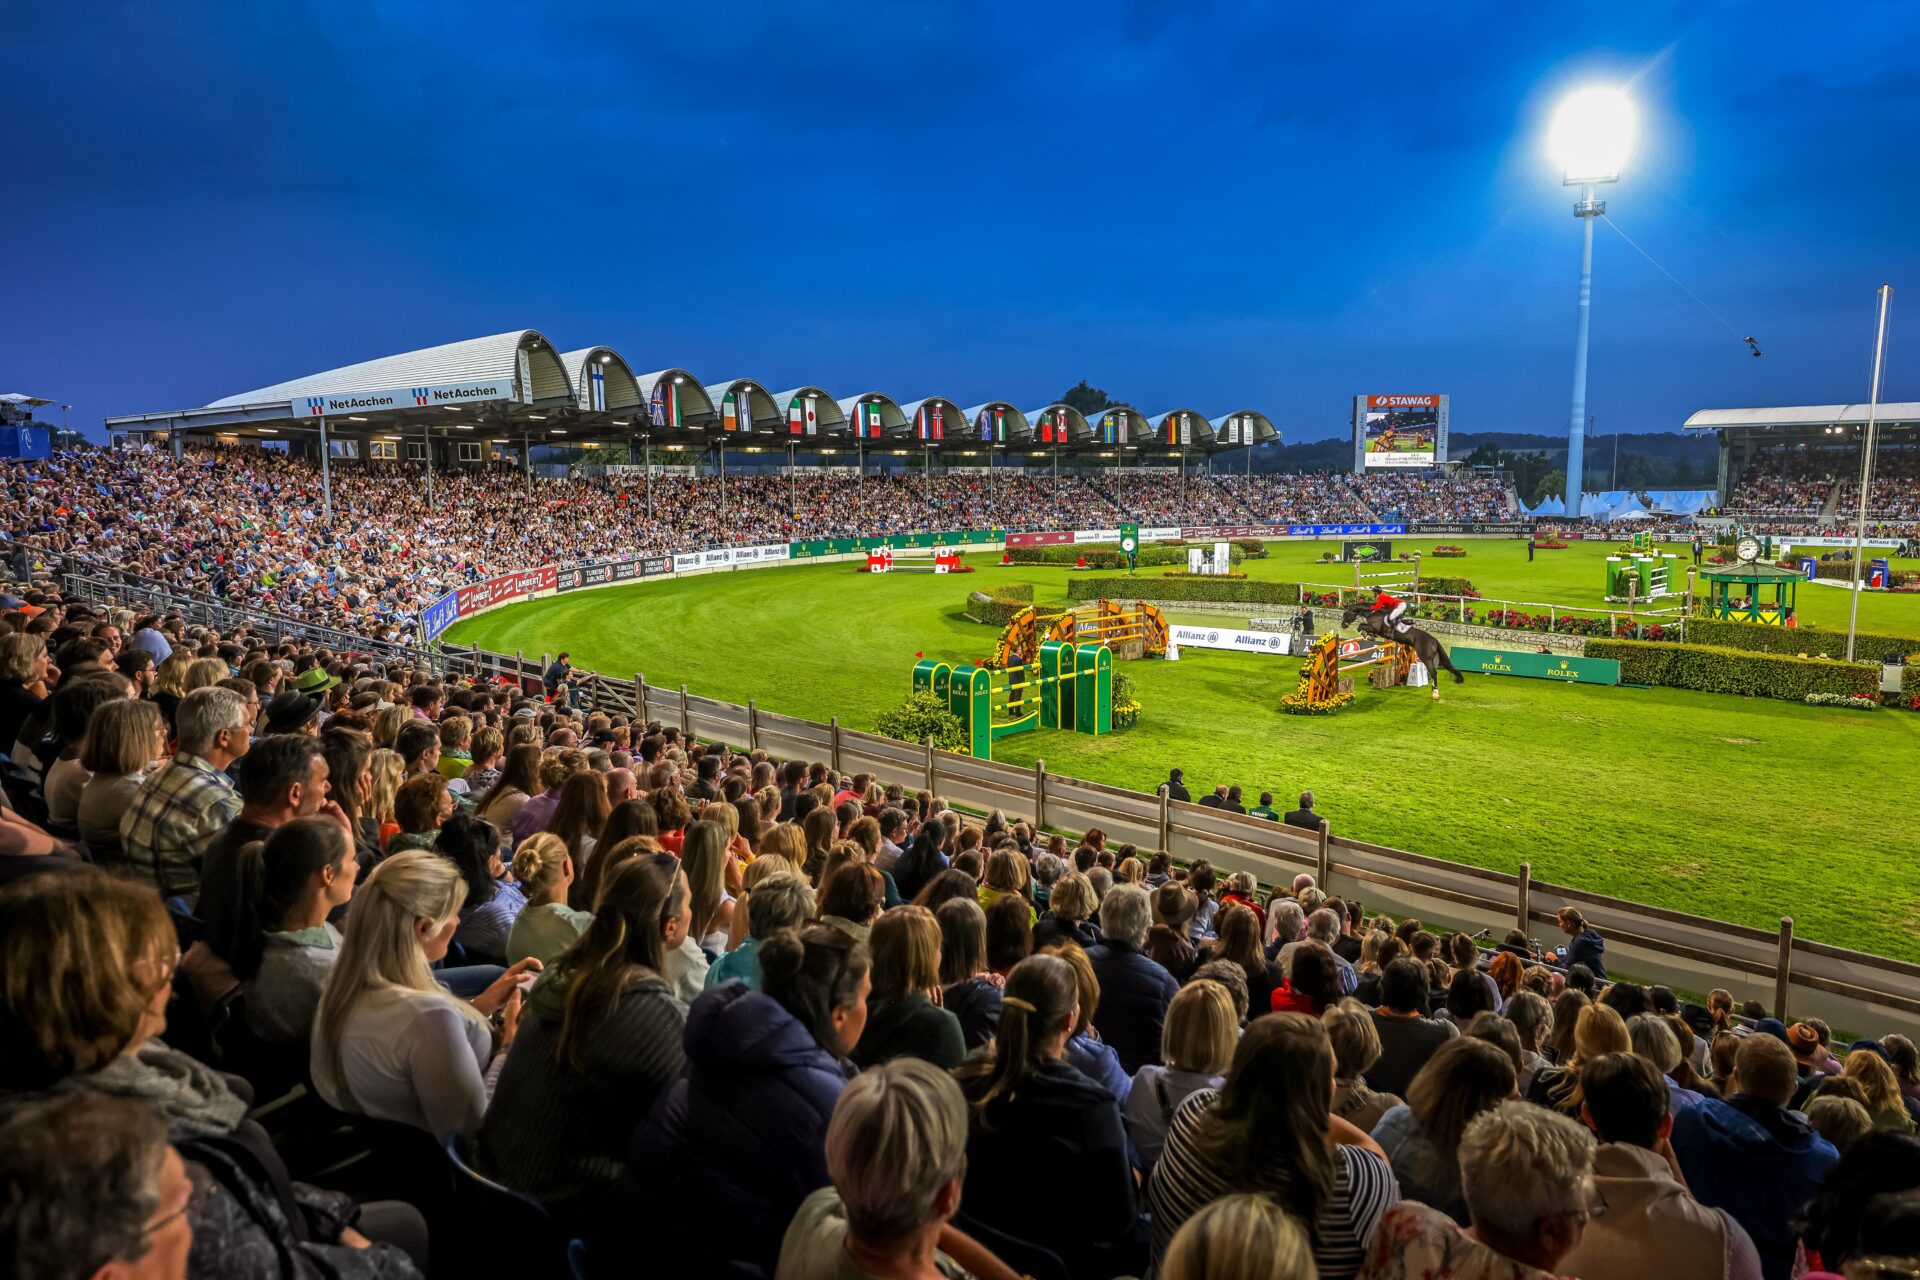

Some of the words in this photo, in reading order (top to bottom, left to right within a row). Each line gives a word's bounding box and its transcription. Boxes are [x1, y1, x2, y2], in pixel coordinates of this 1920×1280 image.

[434, 386, 497, 400] NetAachen
[329, 396, 393, 410] NetAachen
[1389, 396, 1431, 405] STAWAG
[1194, 528, 1220, 536] LAMBERTZ
[1249, 528, 1275, 536] LAMBERTZ
[678, 557, 694, 565] Allianz
[586, 568, 604, 576] TURKISH
[516, 573, 544, 592] LAMBERTZ
[558, 580, 574, 588] AIRLINES
[471, 585, 493, 608] LAMBERTZ
[1176, 630, 1206, 640] Allianz
[1234, 635, 1266, 646] Allianz
[1482, 663, 1511, 672] ROLEX
[1546, 669, 1579, 678] ROLEX
